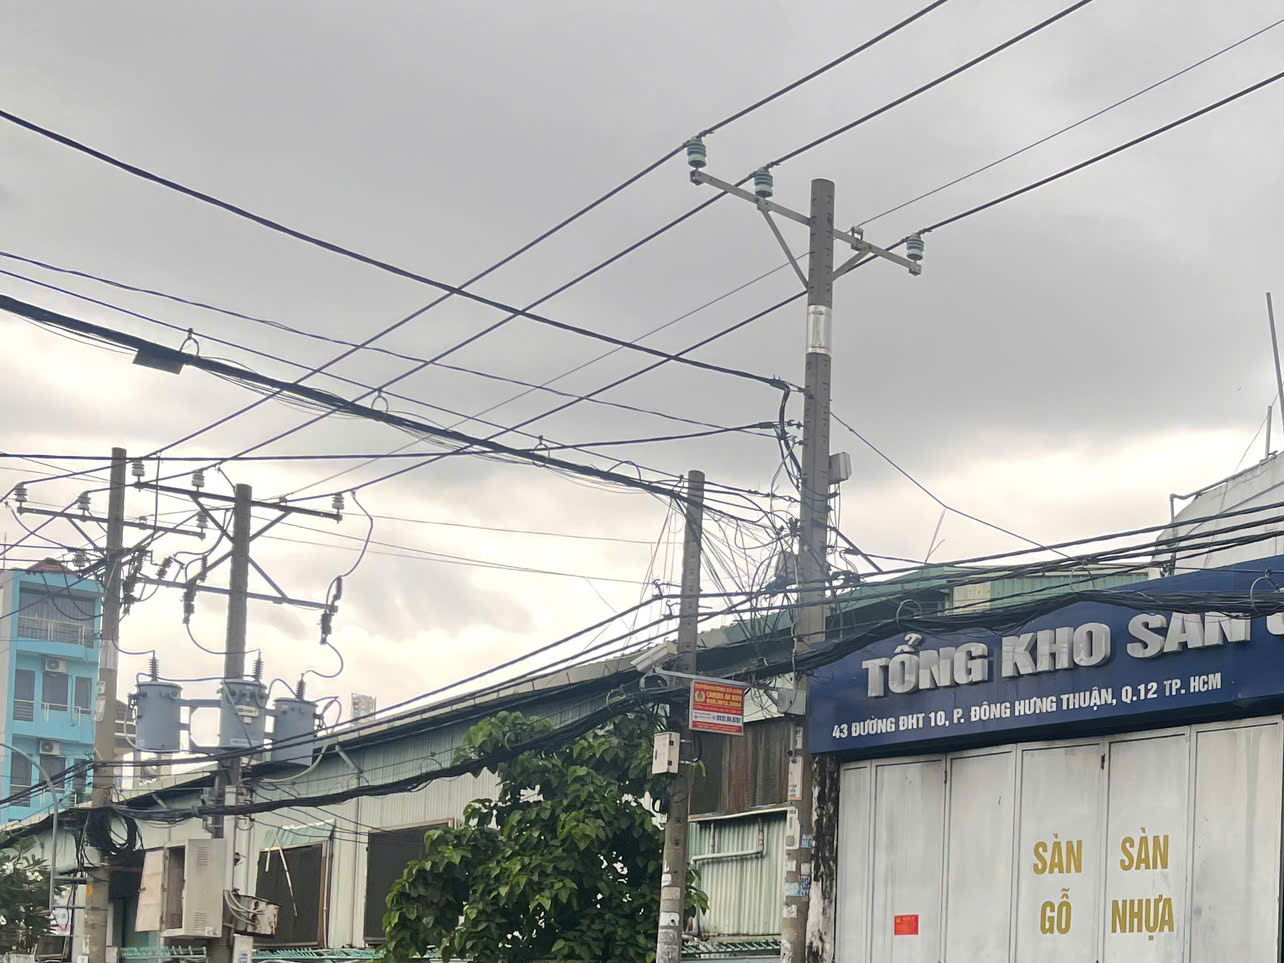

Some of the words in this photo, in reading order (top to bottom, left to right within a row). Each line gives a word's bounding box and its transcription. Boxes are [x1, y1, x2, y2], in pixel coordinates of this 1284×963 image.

[862, 632, 989, 697] TỔNG
[1001, 622, 1112, 678] KHO
[832, 723, 848, 739] 43
[851, 715, 896, 737] ĐƯỜNG
[899, 712, 925, 731] ĐHT
[928, 711, 949, 728] 10,
[953, 708, 965, 724] P.
[970, 701, 1011, 722] ĐÔNG
[1015, 695, 1057, 718] HƯNG
[1060, 686, 1117, 711] THUẬN,
[1121, 682, 1158, 704] Q.12
[1163, 679, 1186, 697] TP.
[1190, 672, 1222, 693] HCM
[1033, 833, 1083, 875] SÀN
[1120, 827, 1169, 871] SÀN
[1040, 888, 1072, 935] GỖ
[1111, 894, 1174, 941] NHỰA
